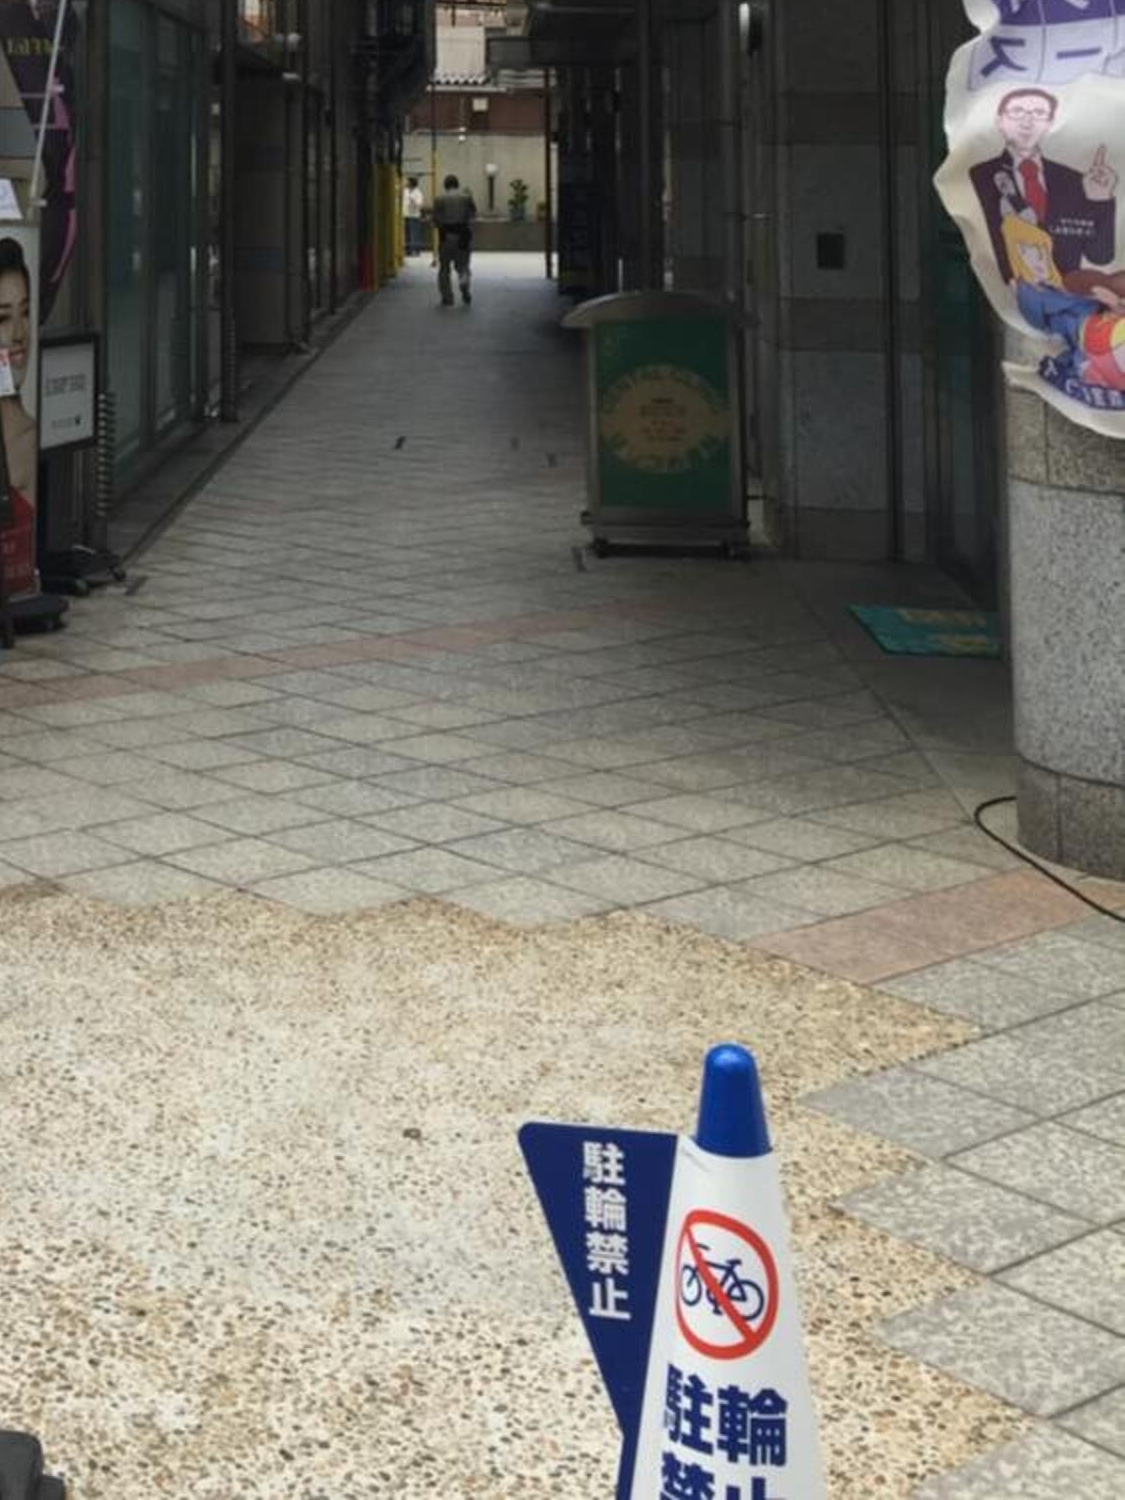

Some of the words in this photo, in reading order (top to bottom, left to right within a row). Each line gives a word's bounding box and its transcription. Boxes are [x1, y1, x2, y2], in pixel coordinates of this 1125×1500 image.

[581, 1140, 632, 1322] 駐輪禁止
[664, 1362, 788, 1467] 駐輪
